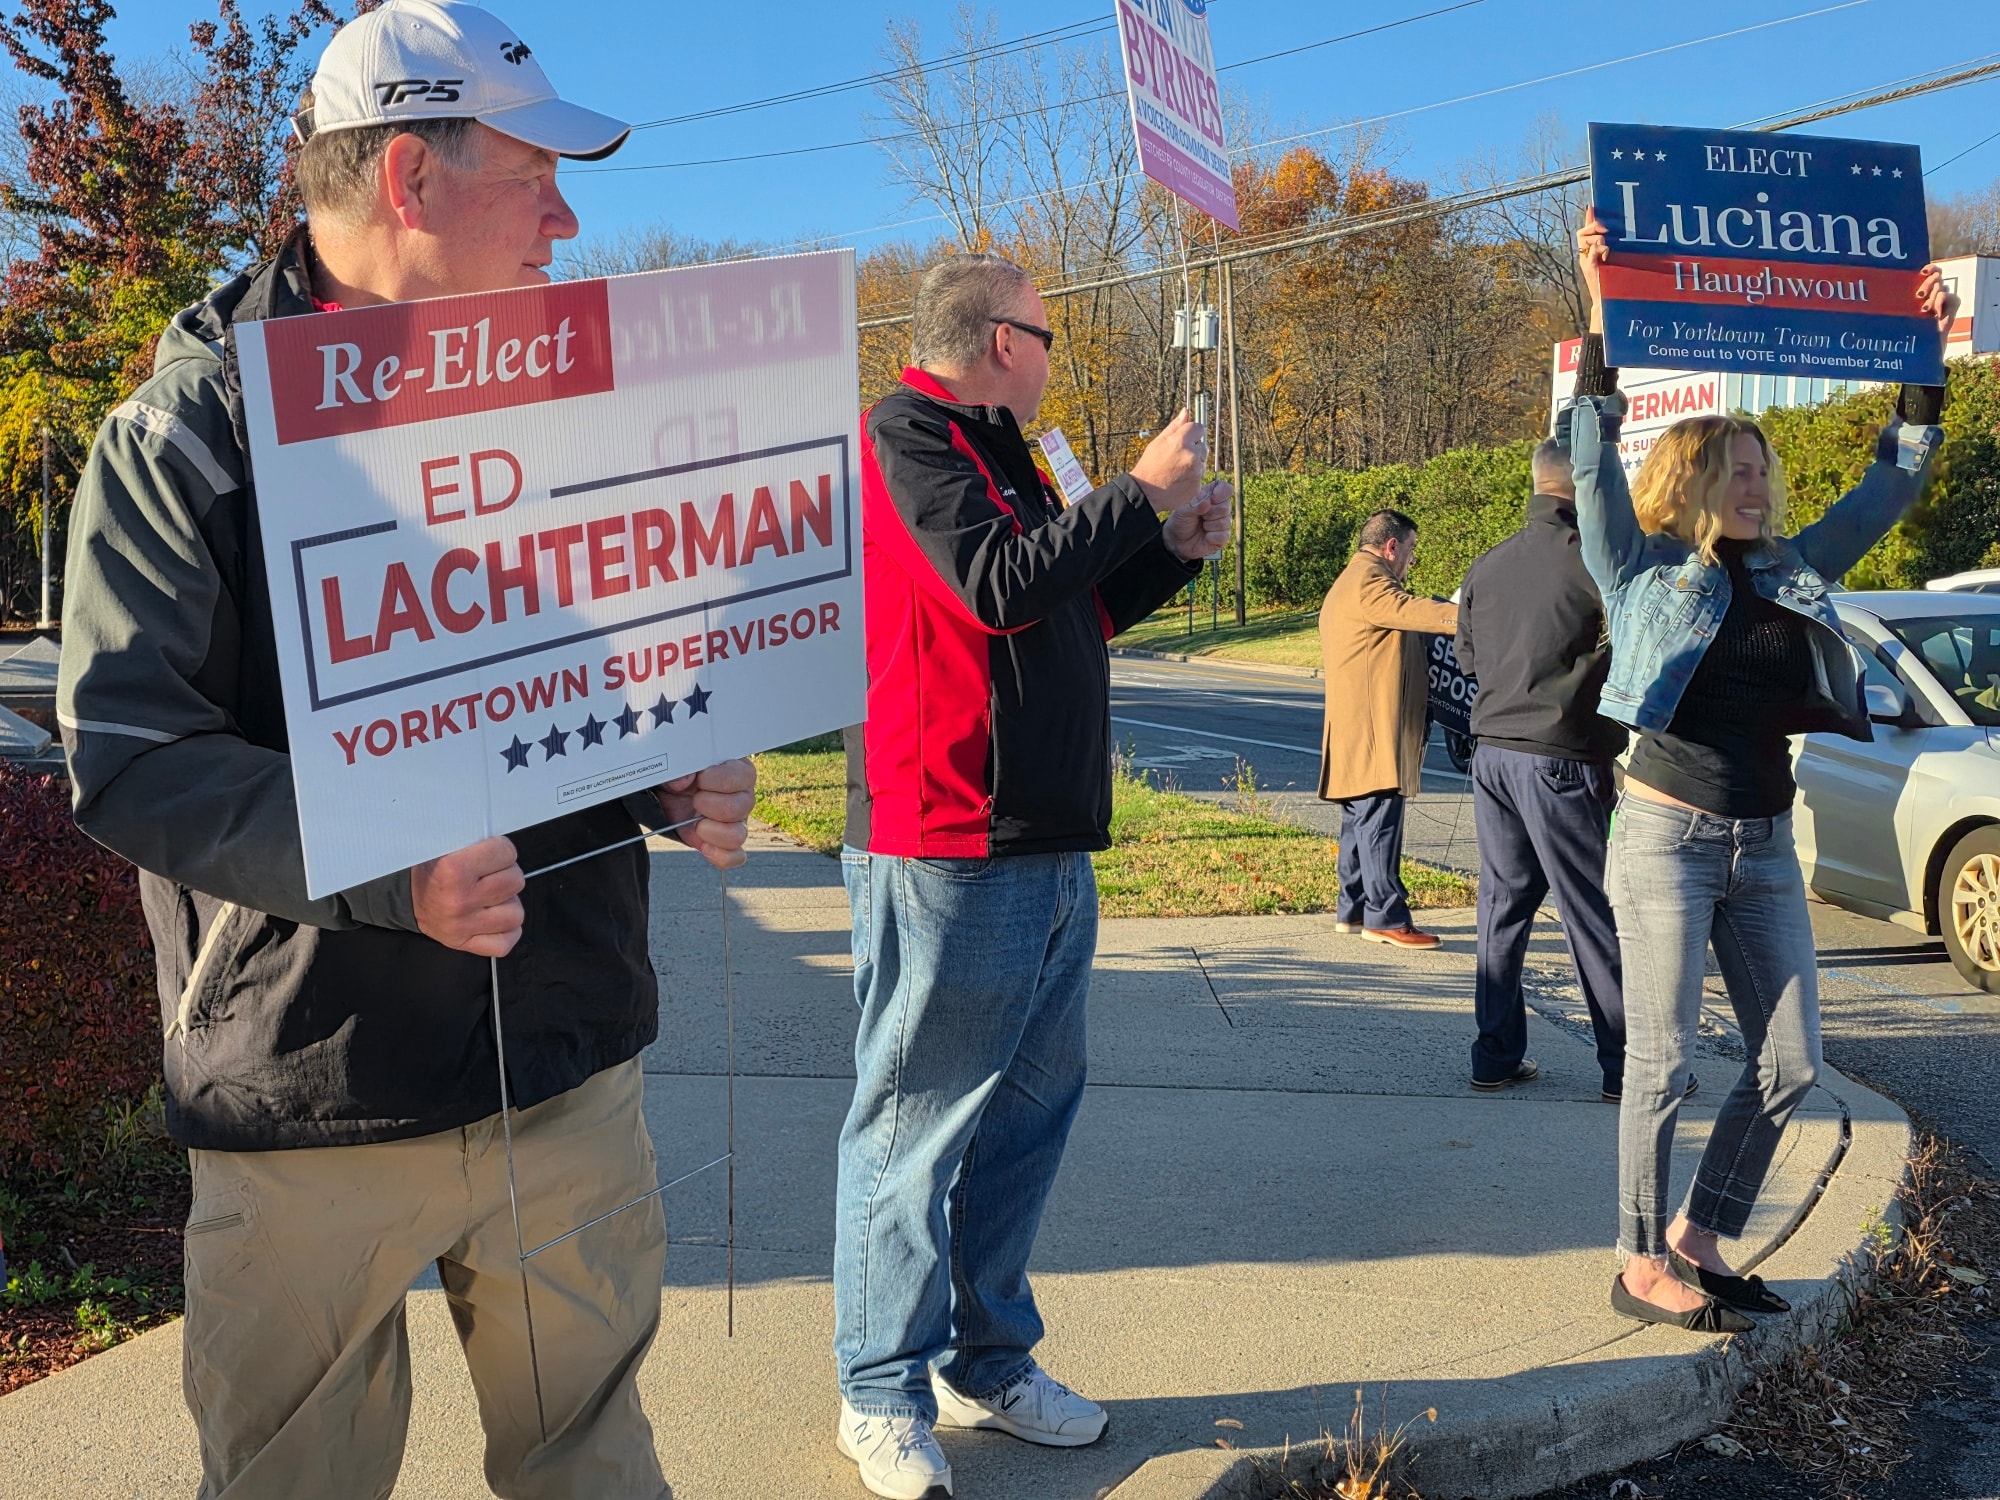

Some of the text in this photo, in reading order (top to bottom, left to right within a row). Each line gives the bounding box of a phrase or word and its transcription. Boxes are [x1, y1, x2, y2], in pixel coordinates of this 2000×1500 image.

[374, 79, 464, 106] TP5
[1119, 0, 1224, 148] BYRNES
[1704, 145, 1812, 178] ELECT
[1616, 181, 1907, 261] Luciana
[1673, 262, 1869, 304] Haughwout
[1627, 319, 1917, 354] For Yorktown Town Council
[1649, 344, 1904, 371] Come out to VOTE on November 2nd!
[314, 316, 578, 411] Re-Elect
[419, 447, 523, 527] ED
[321, 473, 834, 665] LACHTERMAN
[332, 601, 841, 766] YORKTOWN SUPERVISOR
[1429, 696, 1461, 716] RKTOWN
[575, 785, 586, 793] FOR
[593, 773, 626, 788] LACHTERMAN
[626, 770, 636, 778] FOR
